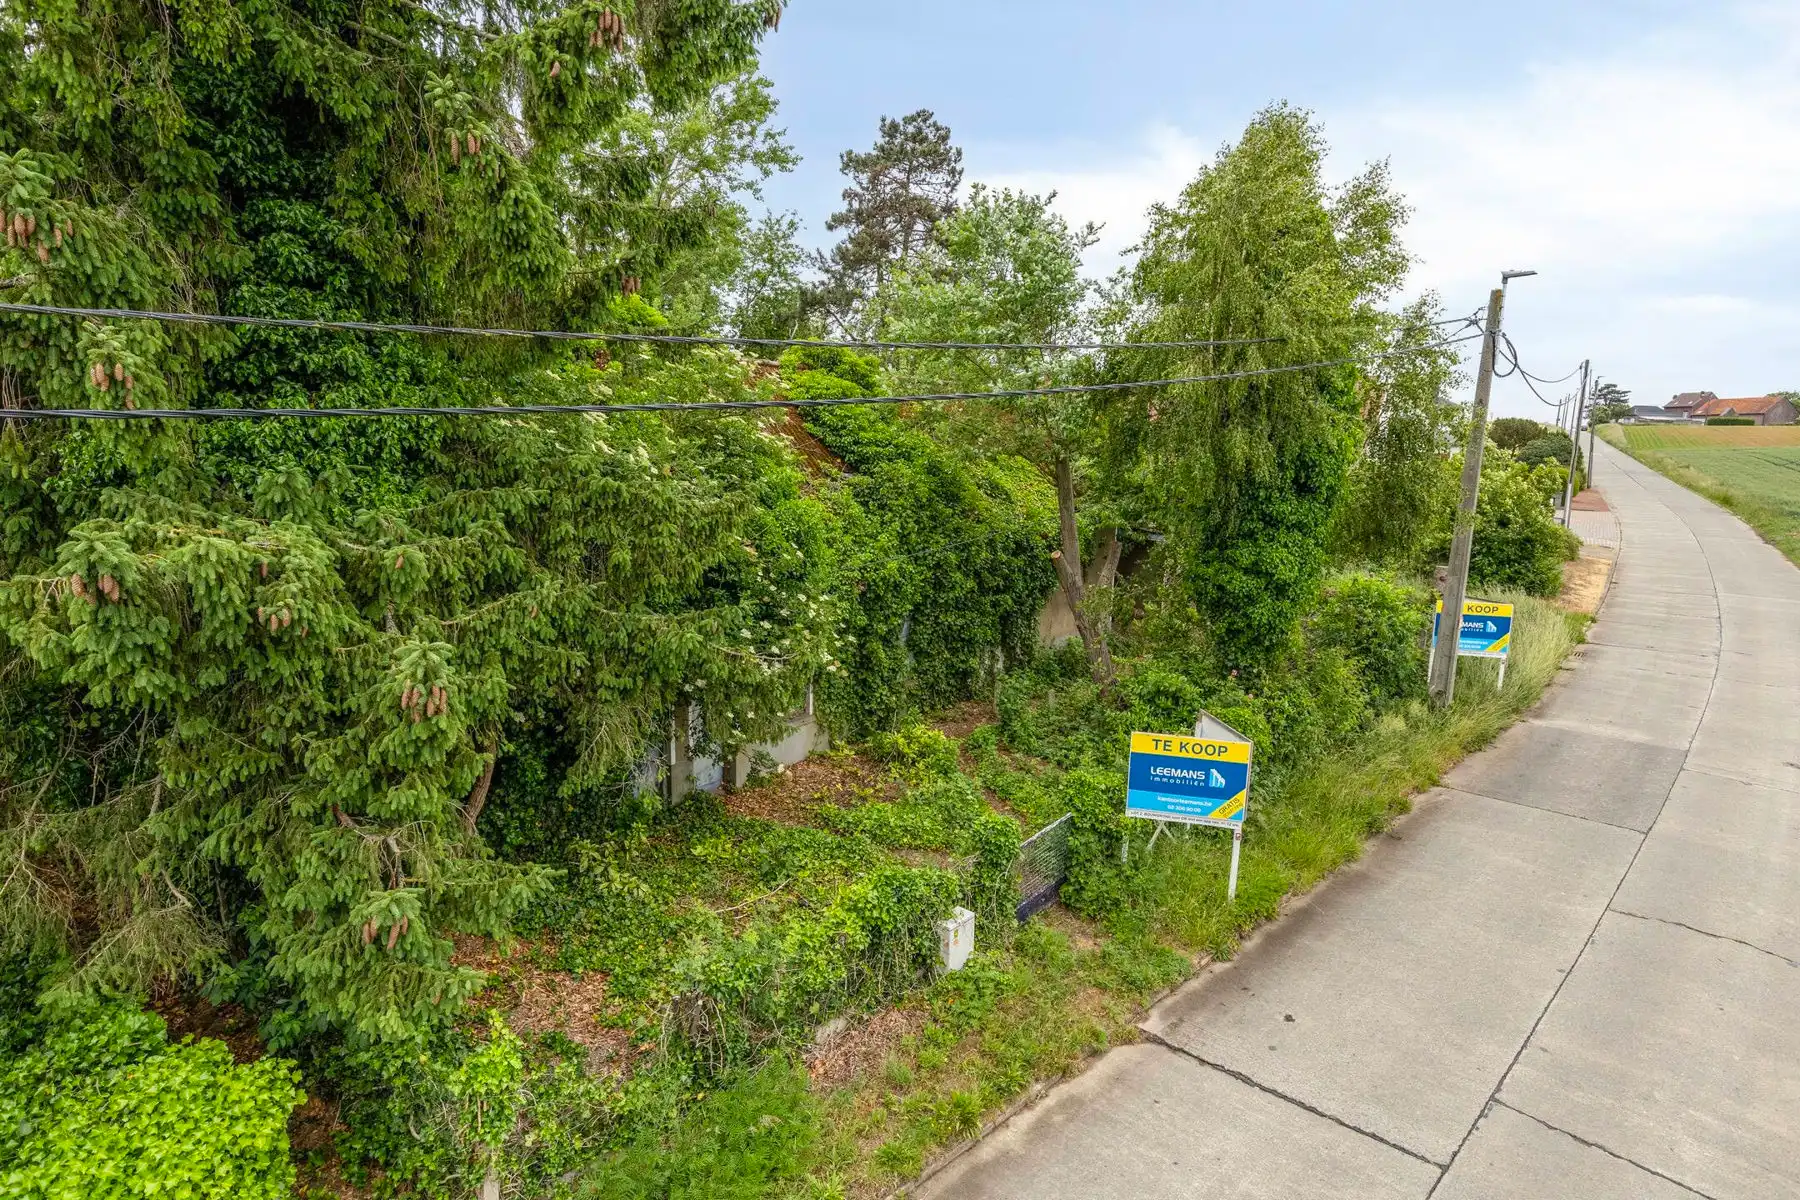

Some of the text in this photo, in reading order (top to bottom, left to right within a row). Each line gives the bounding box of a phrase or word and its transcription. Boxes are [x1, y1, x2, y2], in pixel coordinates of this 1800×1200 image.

[1467, 605, 1499, 613] KOOP
[1152, 738, 1229, 757] TE KOOP
[1150, 765, 1206, 780] LEEMANS
[1218, 797, 1240, 815] GRATIS
